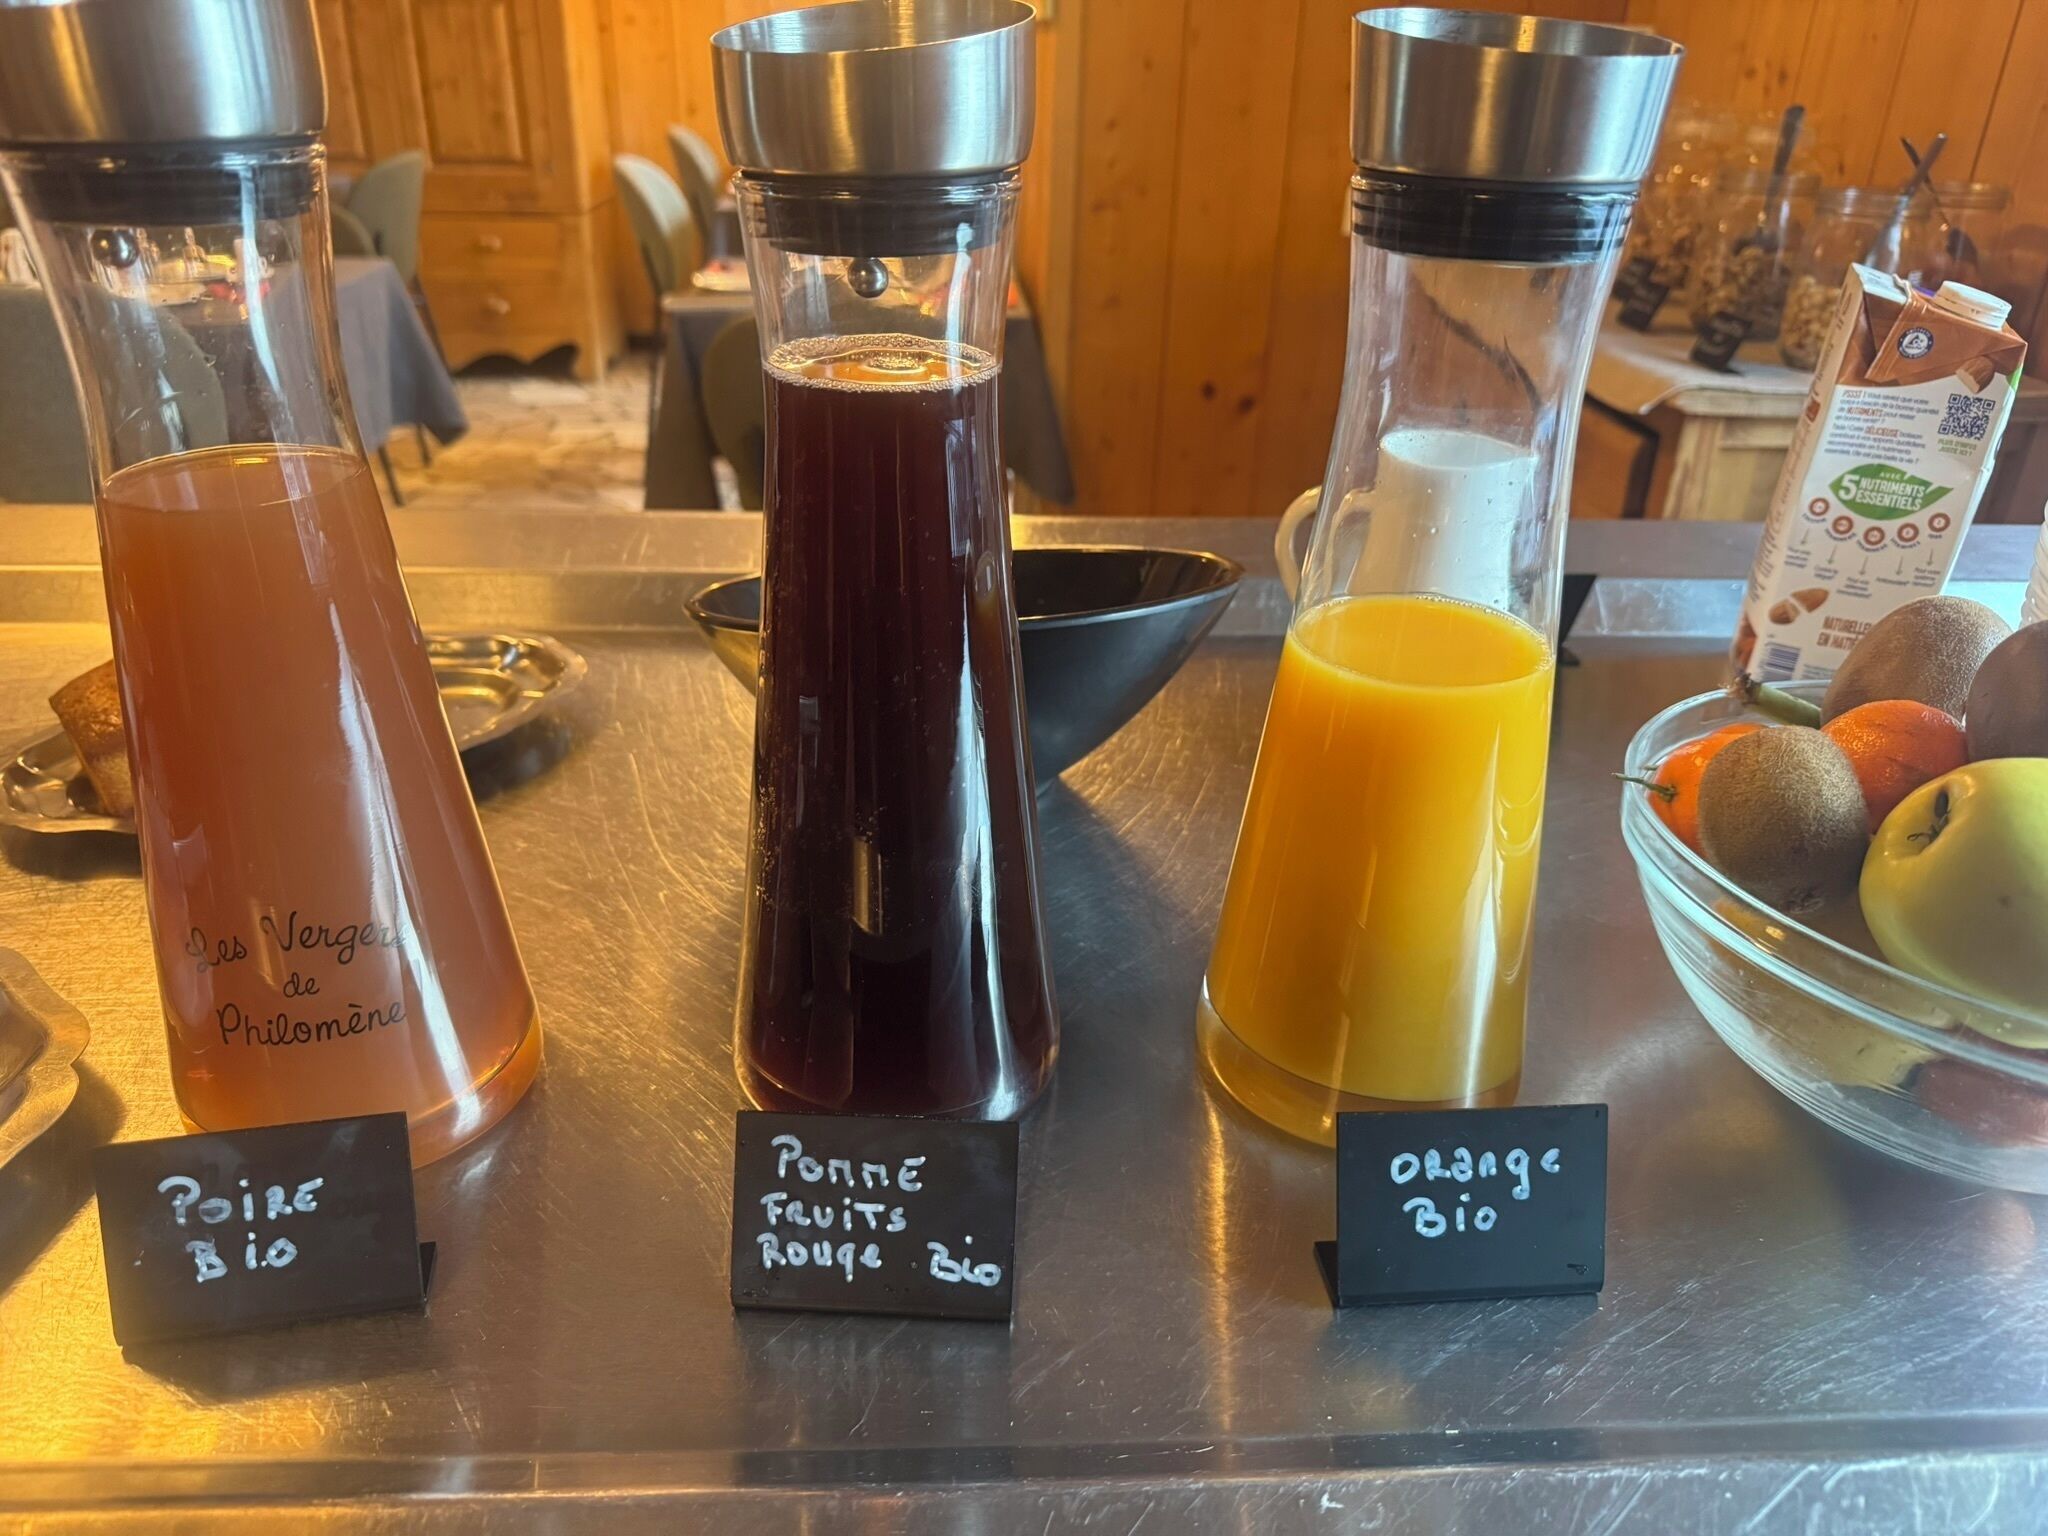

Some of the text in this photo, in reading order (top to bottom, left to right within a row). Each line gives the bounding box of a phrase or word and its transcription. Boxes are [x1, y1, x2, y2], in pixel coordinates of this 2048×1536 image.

[1838, 474, 1926, 500] 5 NUTRIMENTS
[1856, 490, 1923, 512] ESSENTIELS
[185, 911, 408, 973] Les Vergers
[283, 971, 320, 998] de
[216, 999, 408, 1047] Philomène
[1402, 1192, 1498, 1238] Bio
[926, 1234, 1002, 1287] Bio
